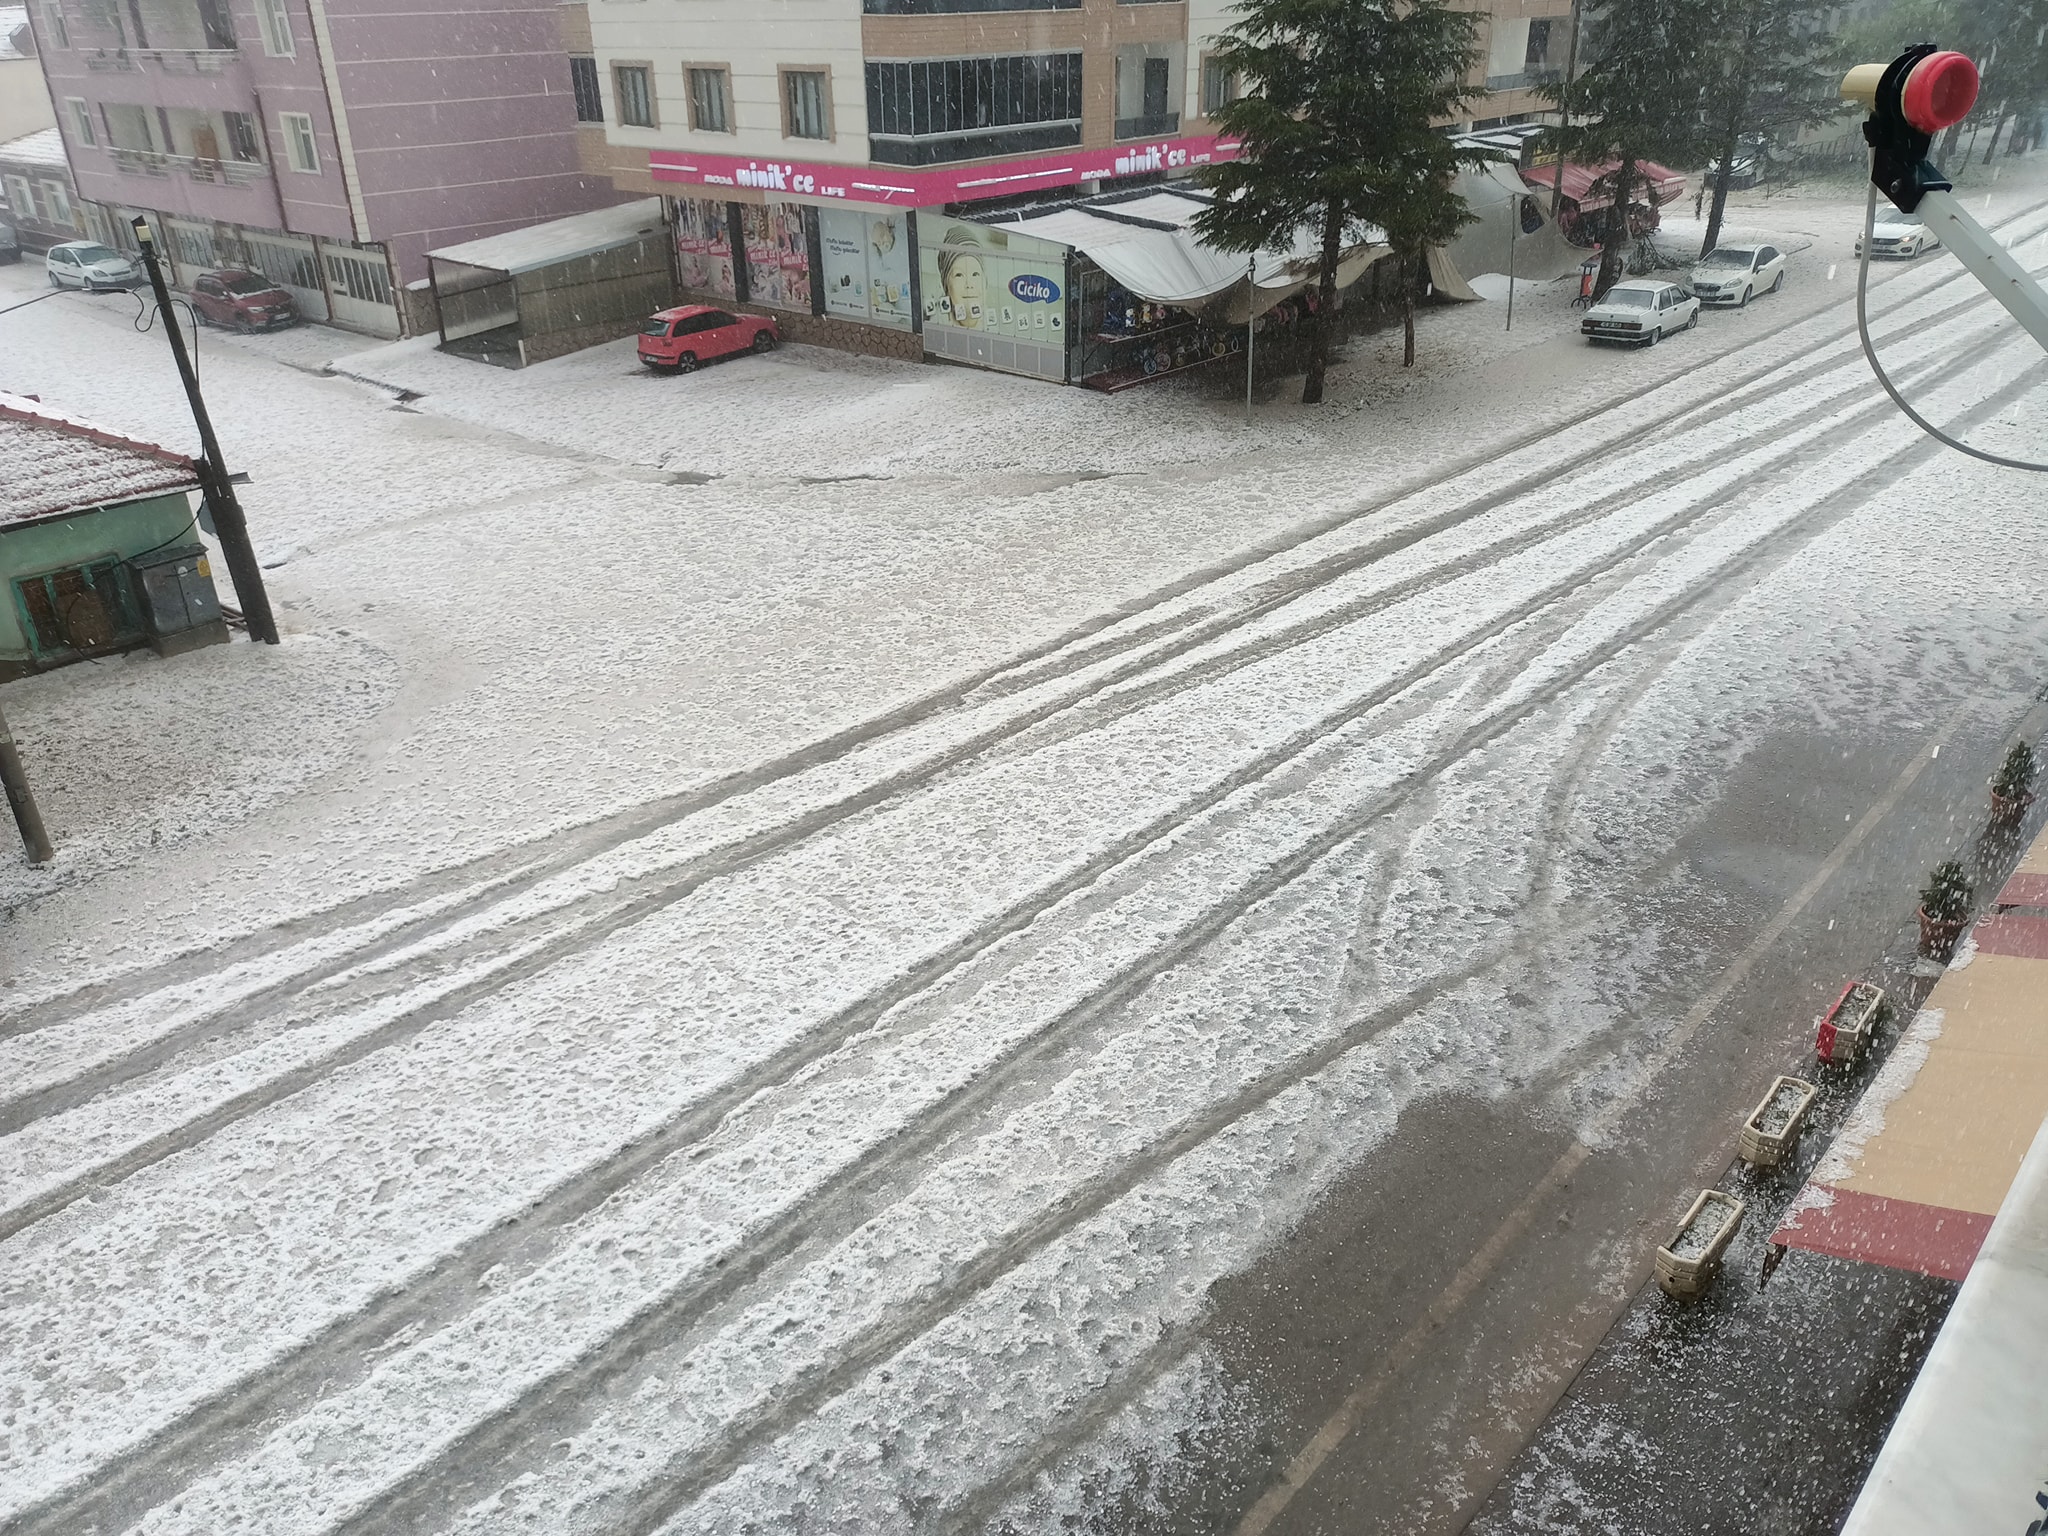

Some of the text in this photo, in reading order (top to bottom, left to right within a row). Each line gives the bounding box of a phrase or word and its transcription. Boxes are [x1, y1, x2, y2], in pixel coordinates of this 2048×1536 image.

[1081, 169, 1111, 180] MODA
[1190, 153, 1210, 164] LIFE
[821, 186, 846, 197] LIFE
[1016, 280, 1051, 299] Ciciko
